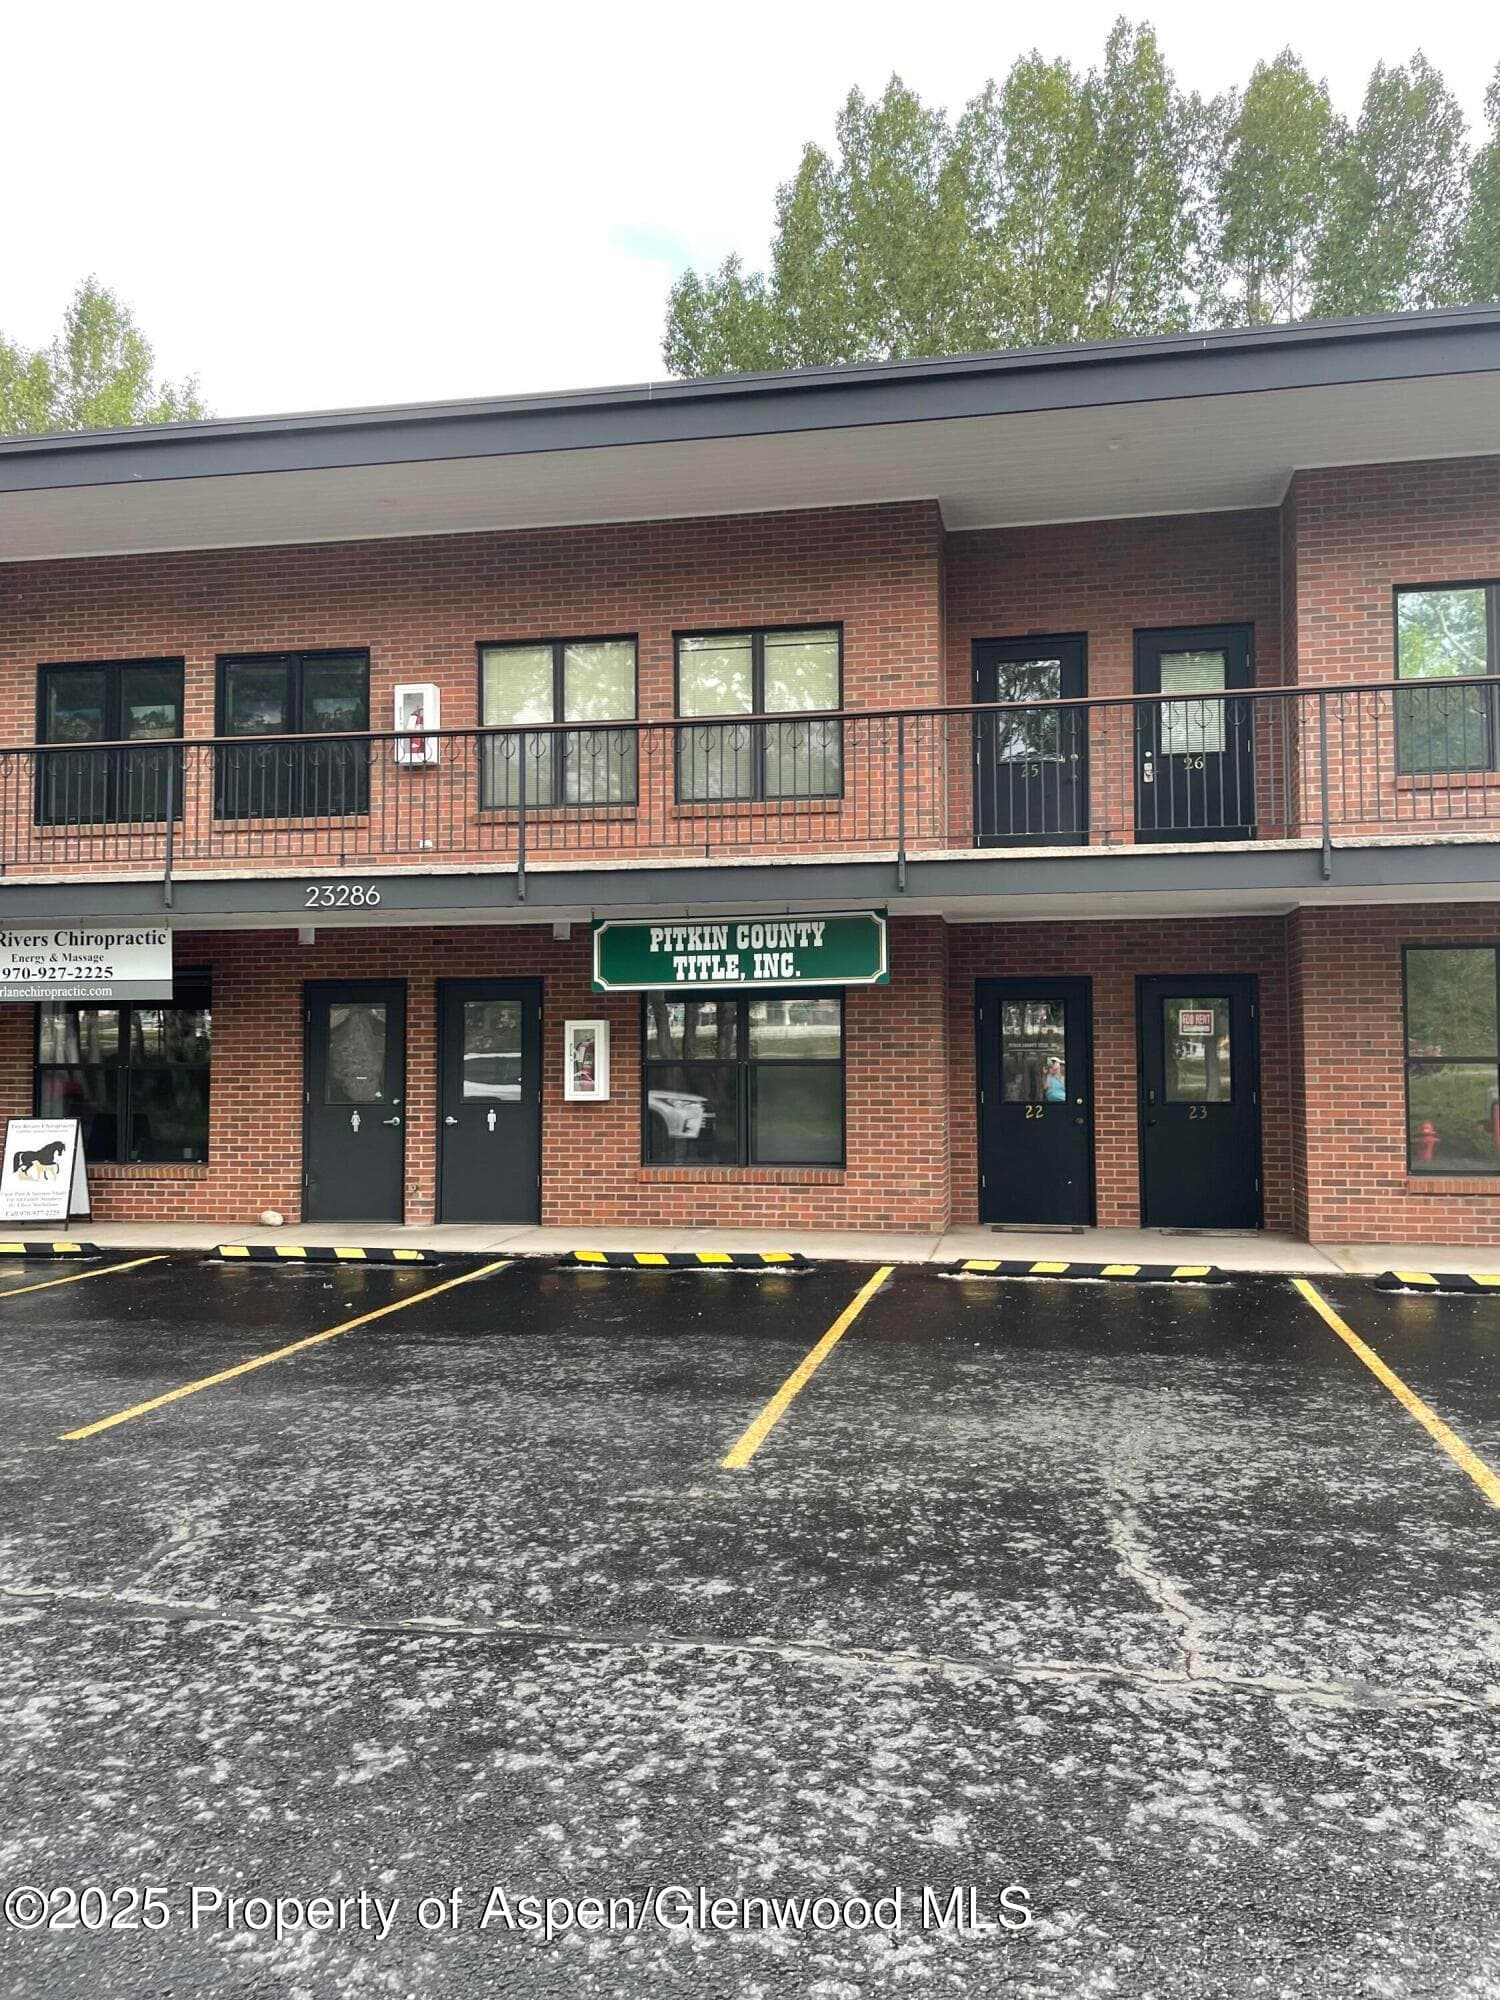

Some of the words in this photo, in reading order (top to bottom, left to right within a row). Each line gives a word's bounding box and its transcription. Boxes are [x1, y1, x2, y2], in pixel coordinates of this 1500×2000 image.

[1183, 756, 1204, 770] 26
[304, 885, 380, 907] 23286
[0, 932, 48, 947] Rivers
[54, 930, 167, 949] Chiropractic
[650, 926, 728, 952] PITKIN
[736, 922, 826, 949] COUNTY
[11, 954, 46, 964] Energy
[49, 953, 58, 962] &
[62, 953, 104, 962] Massage
[2, 966, 113, 979] 970-927-2225
[673, 954, 745, 981] TITLE,
[753, 952, 800, 978] INC.
[1025, 1105, 1044, 1119] 22
[1189, 1105, 1207, 1119] 23
